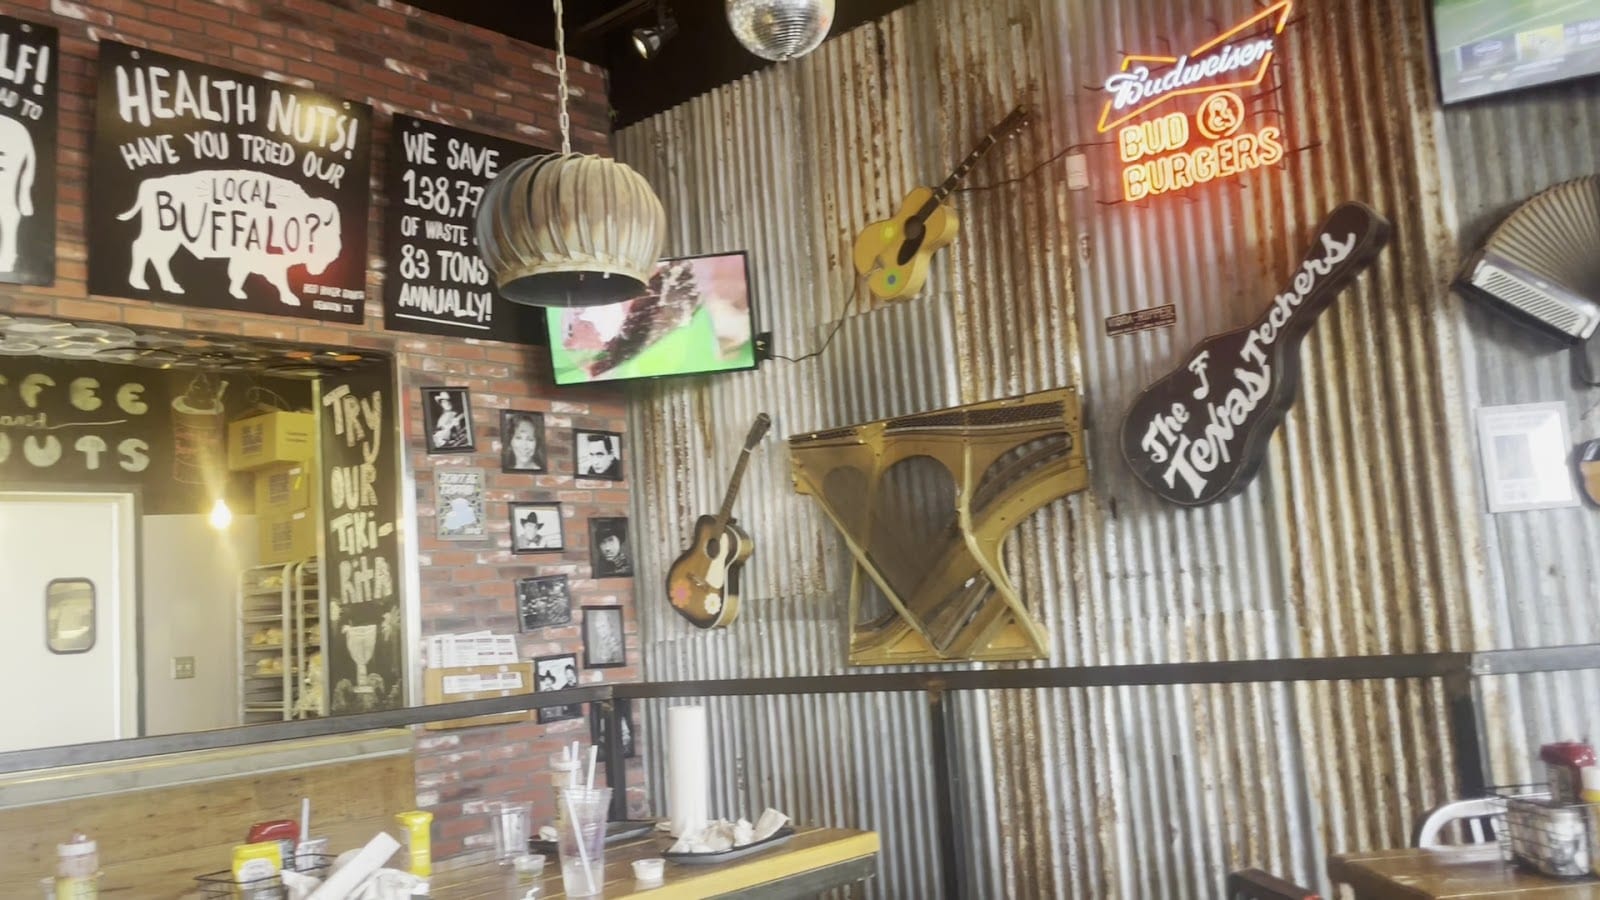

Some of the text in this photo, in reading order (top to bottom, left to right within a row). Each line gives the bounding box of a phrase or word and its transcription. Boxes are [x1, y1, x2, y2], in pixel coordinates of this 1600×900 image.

[1105, 39, 1274, 109] Budweiser
[20, 98, 43, 120] TO
[115, 65, 358, 159] HEALTH NUTS!
[120, 134, 181, 170] HAVE
[184, 130, 230, 160] YOU
[302, 151, 346, 190] OUR
[402, 131, 500, 180] WE SAVE
[1119, 112, 1190, 162] BUD
[1123, 126, 1284, 202] BURGERS
[212, 177, 277, 210] LOCAL
[402, 169, 485, 219] 138,77
[156, 190, 323, 255] BUFFALO?
[400, 215, 421, 237] OF
[425, 220, 469, 247] WASTE
[399, 243, 490, 286] 83 TONS
[398, 282, 493, 323] ANNUALLY!
[0, 372, 149, 415] FEE
[1141, 402, 1191, 463] The
[1161, 364, 1272, 499] Texas
[330, 463, 379, 510] OUR
